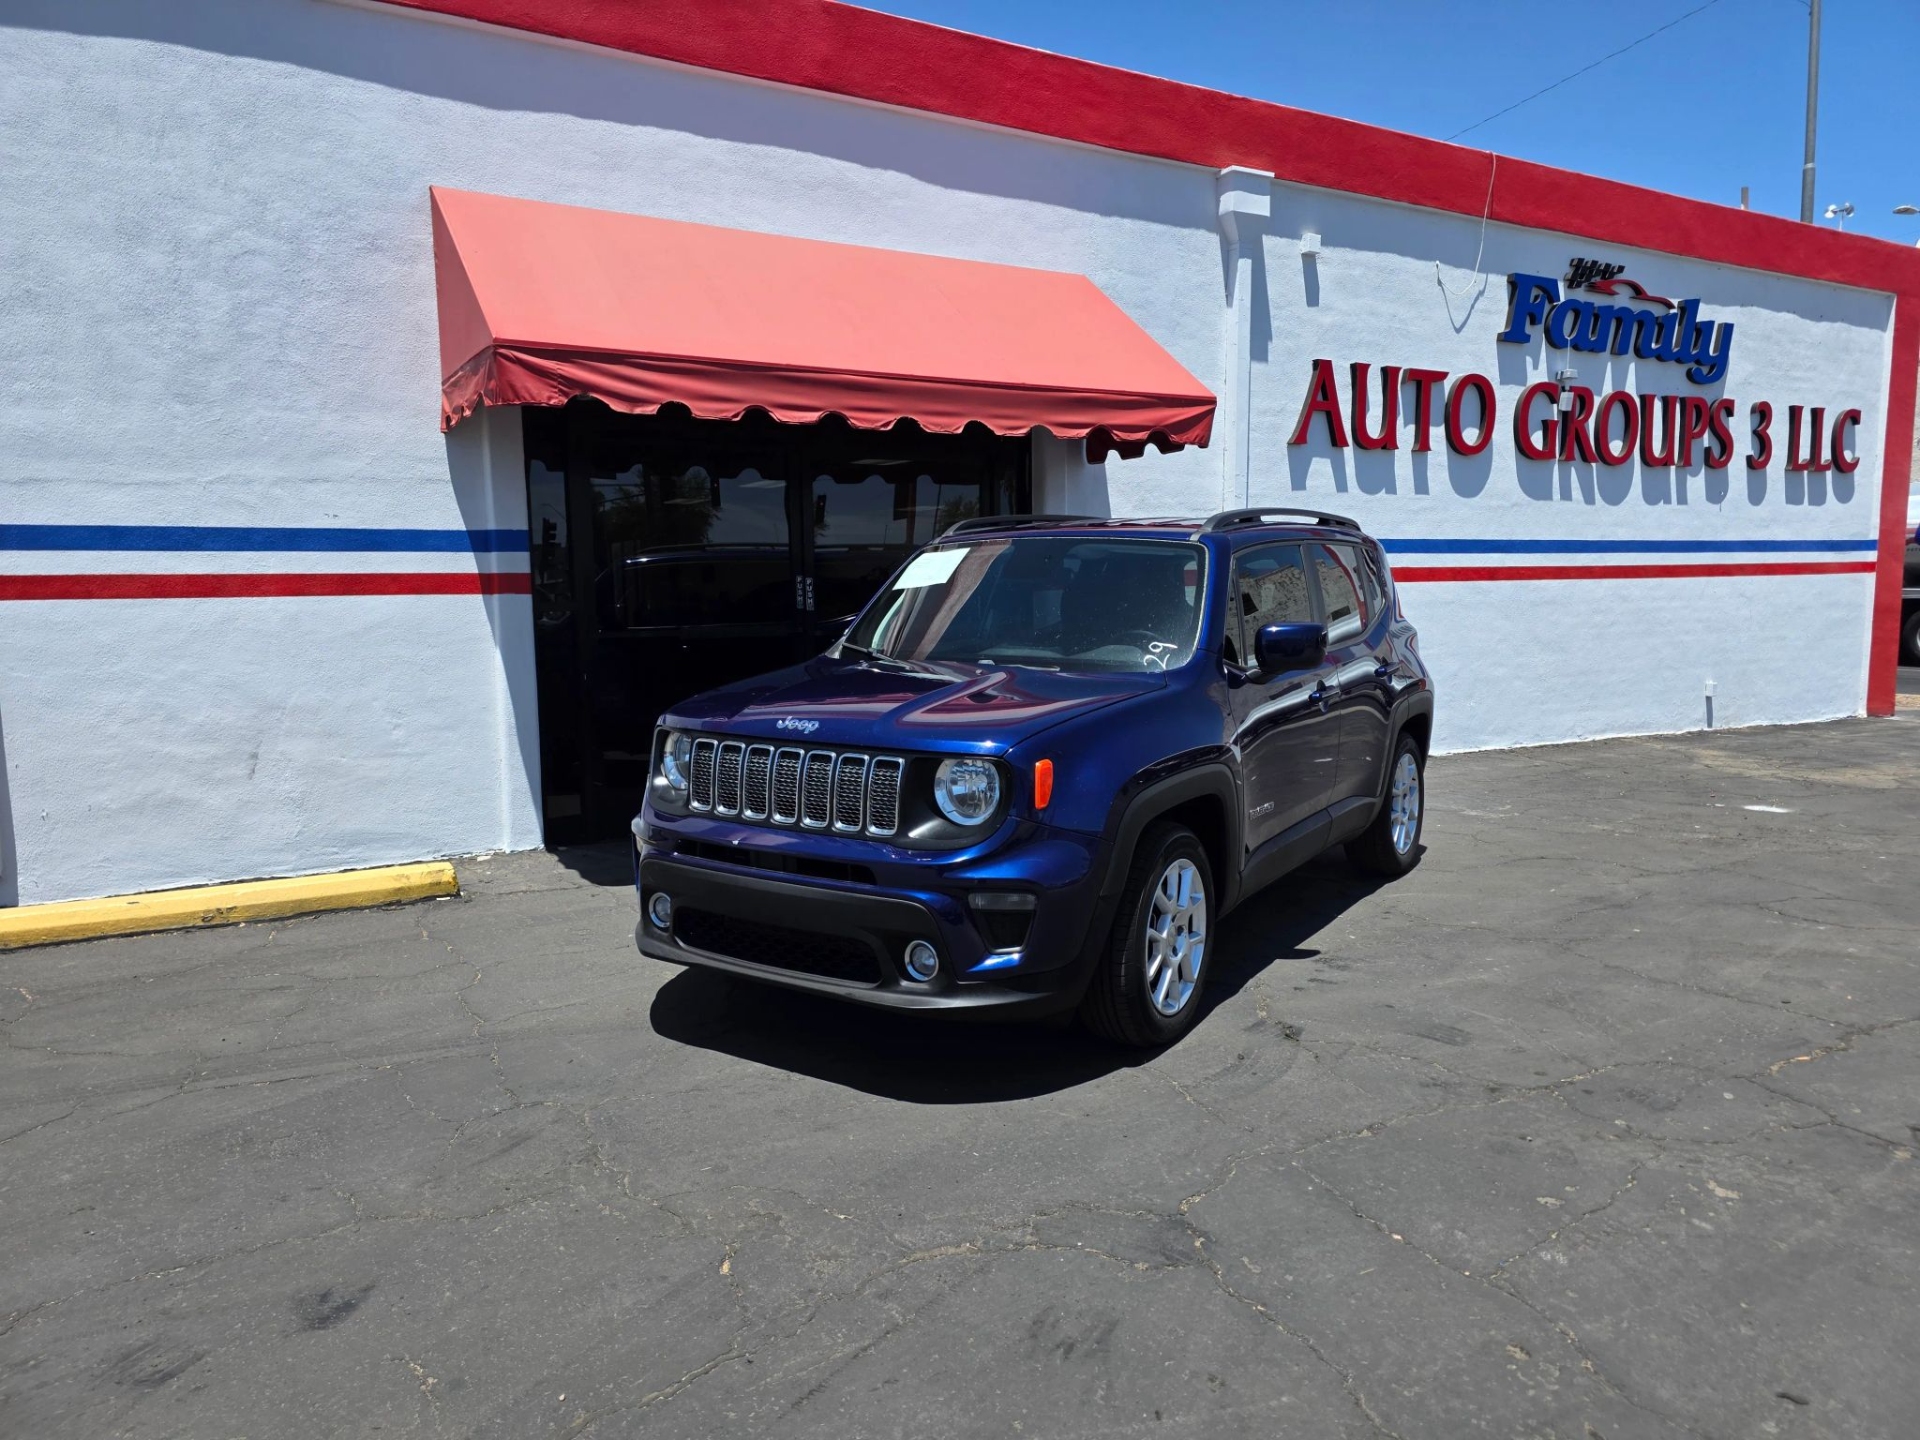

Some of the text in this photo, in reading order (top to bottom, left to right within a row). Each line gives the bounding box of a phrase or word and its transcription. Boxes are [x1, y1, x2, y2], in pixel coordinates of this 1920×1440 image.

[1497, 273, 1734, 385] Family
[1288, 359, 1861, 474] AUTO GROUPS 3 LLC
[776, 716, 819, 734] Jeep
